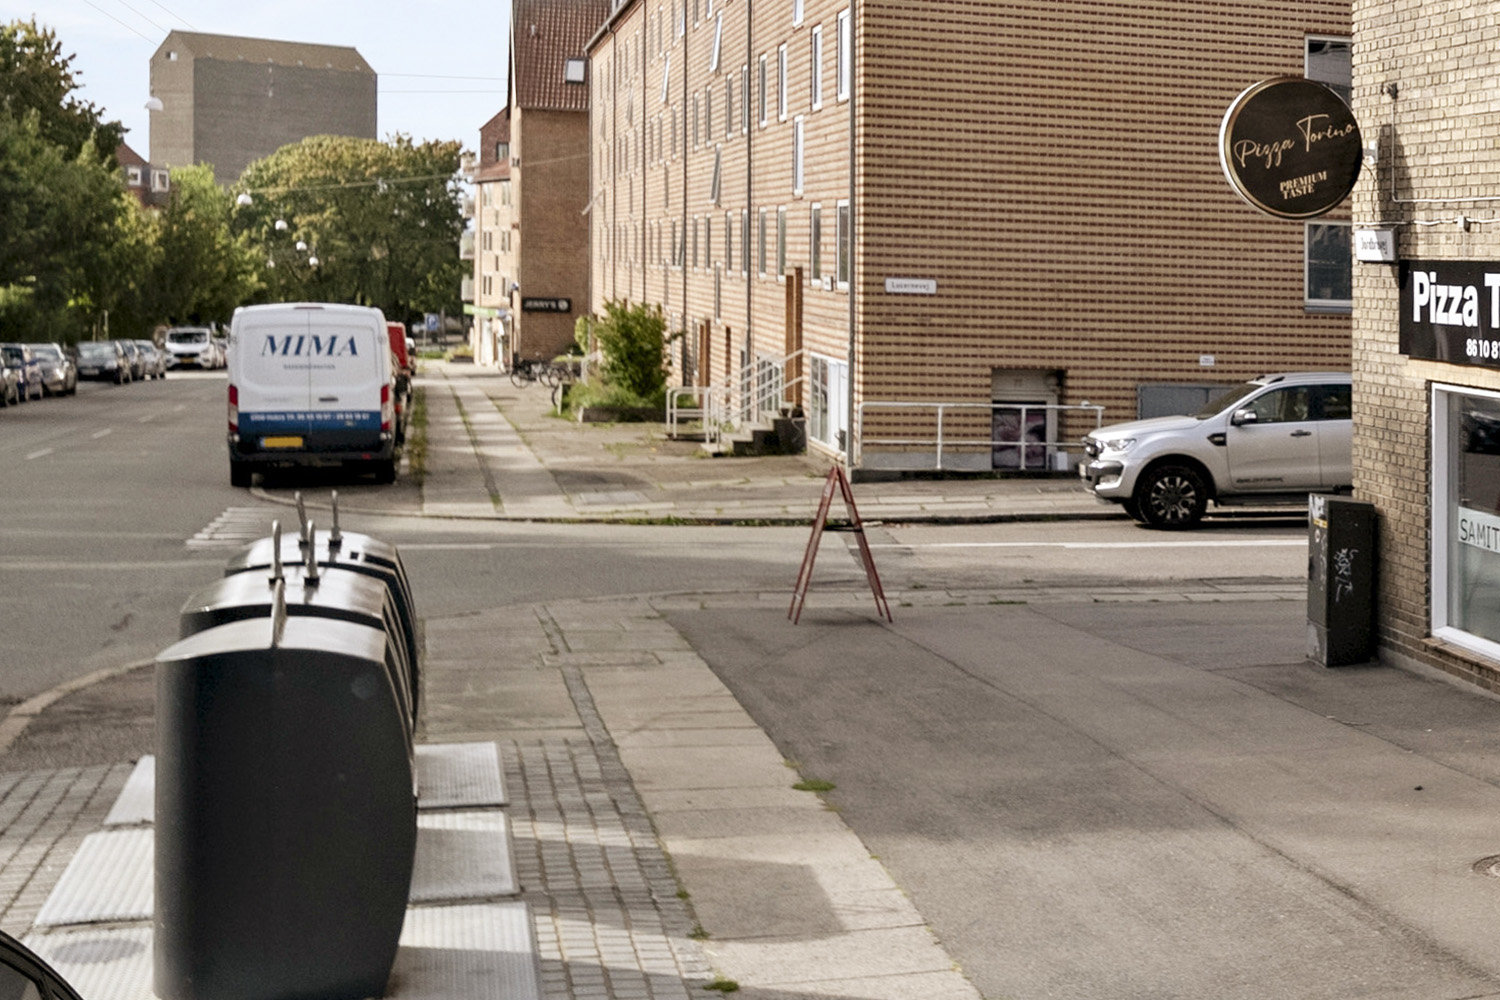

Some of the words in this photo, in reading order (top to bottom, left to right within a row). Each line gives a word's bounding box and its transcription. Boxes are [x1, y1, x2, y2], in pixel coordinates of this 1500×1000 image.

[1234, 139, 1295, 169] Pizza
[1296, 113, 1355, 152] Torino
[1280, 171, 1327, 191] PREMIUM
[1283, 183, 1315, 200] TASTE
[1412, 271, 1478, 327] Pizza
[261, 334, 358, 357] MIMA
[1466, 338, 1477, 357] 86
[1478, 339, 1490, 358] 10
